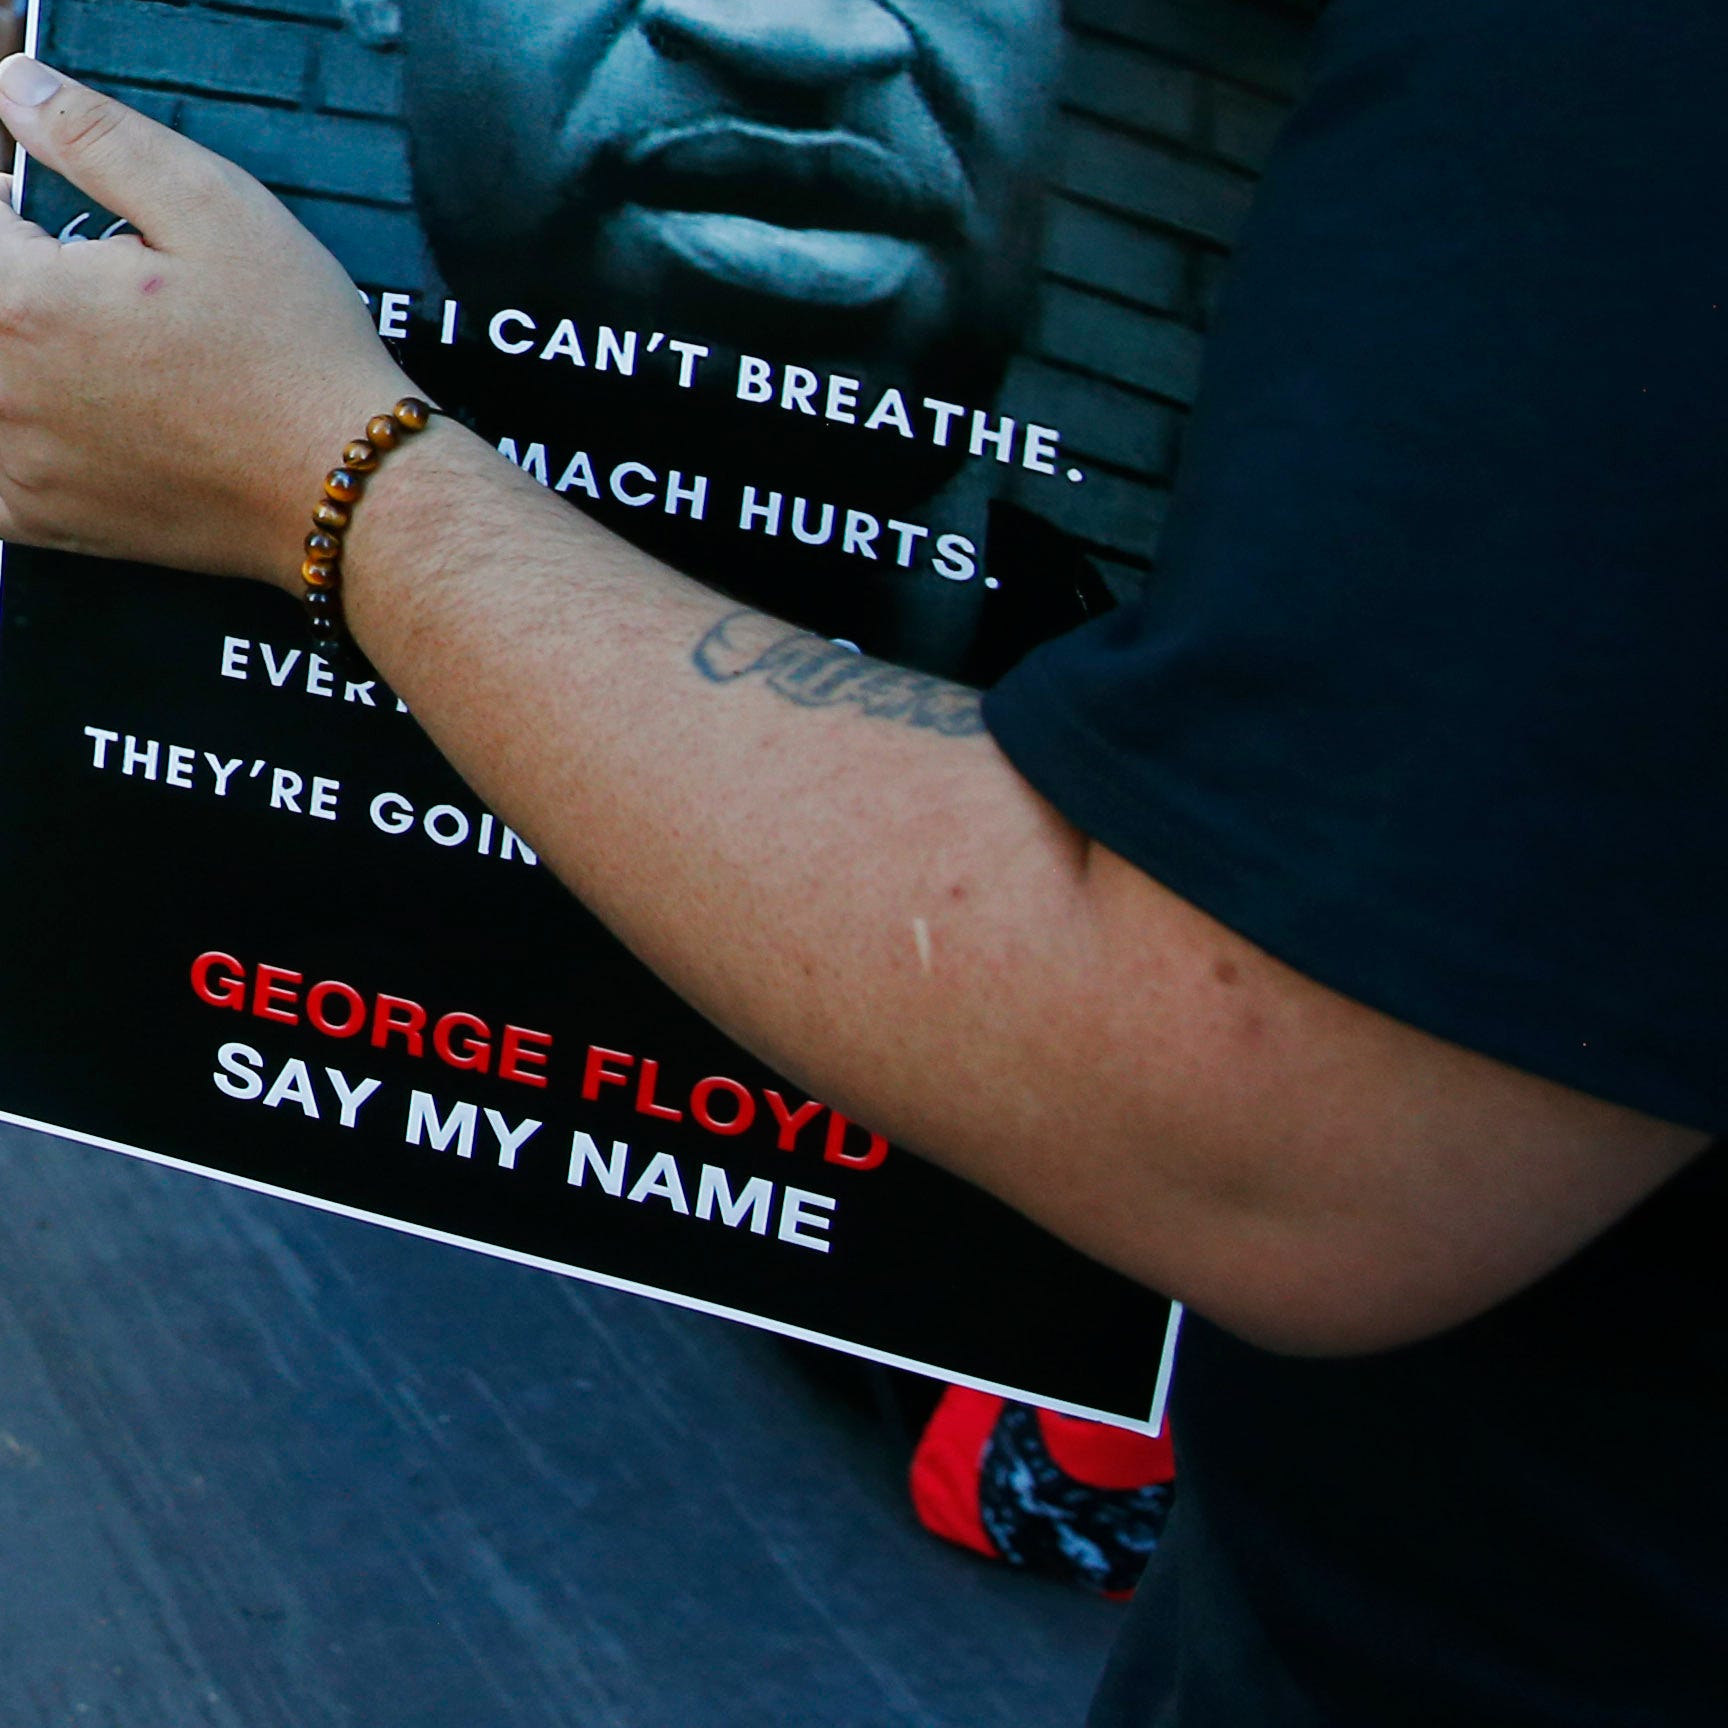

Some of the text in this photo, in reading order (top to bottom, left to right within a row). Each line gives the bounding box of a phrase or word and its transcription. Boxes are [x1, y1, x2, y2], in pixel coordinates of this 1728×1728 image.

[357, 289, 1084, 483] E I CAN'T BREATHE.
[496, 436, 1000, 590] MACH HURTS.
[220, 636, 409, 713] EVER
[83, 725, 539, 867] THEY'RE GOIN
[189, 952, 890, 1171] GEORGE FLOYD
[213, 1042, 838, 1254] SAY MY NAME
